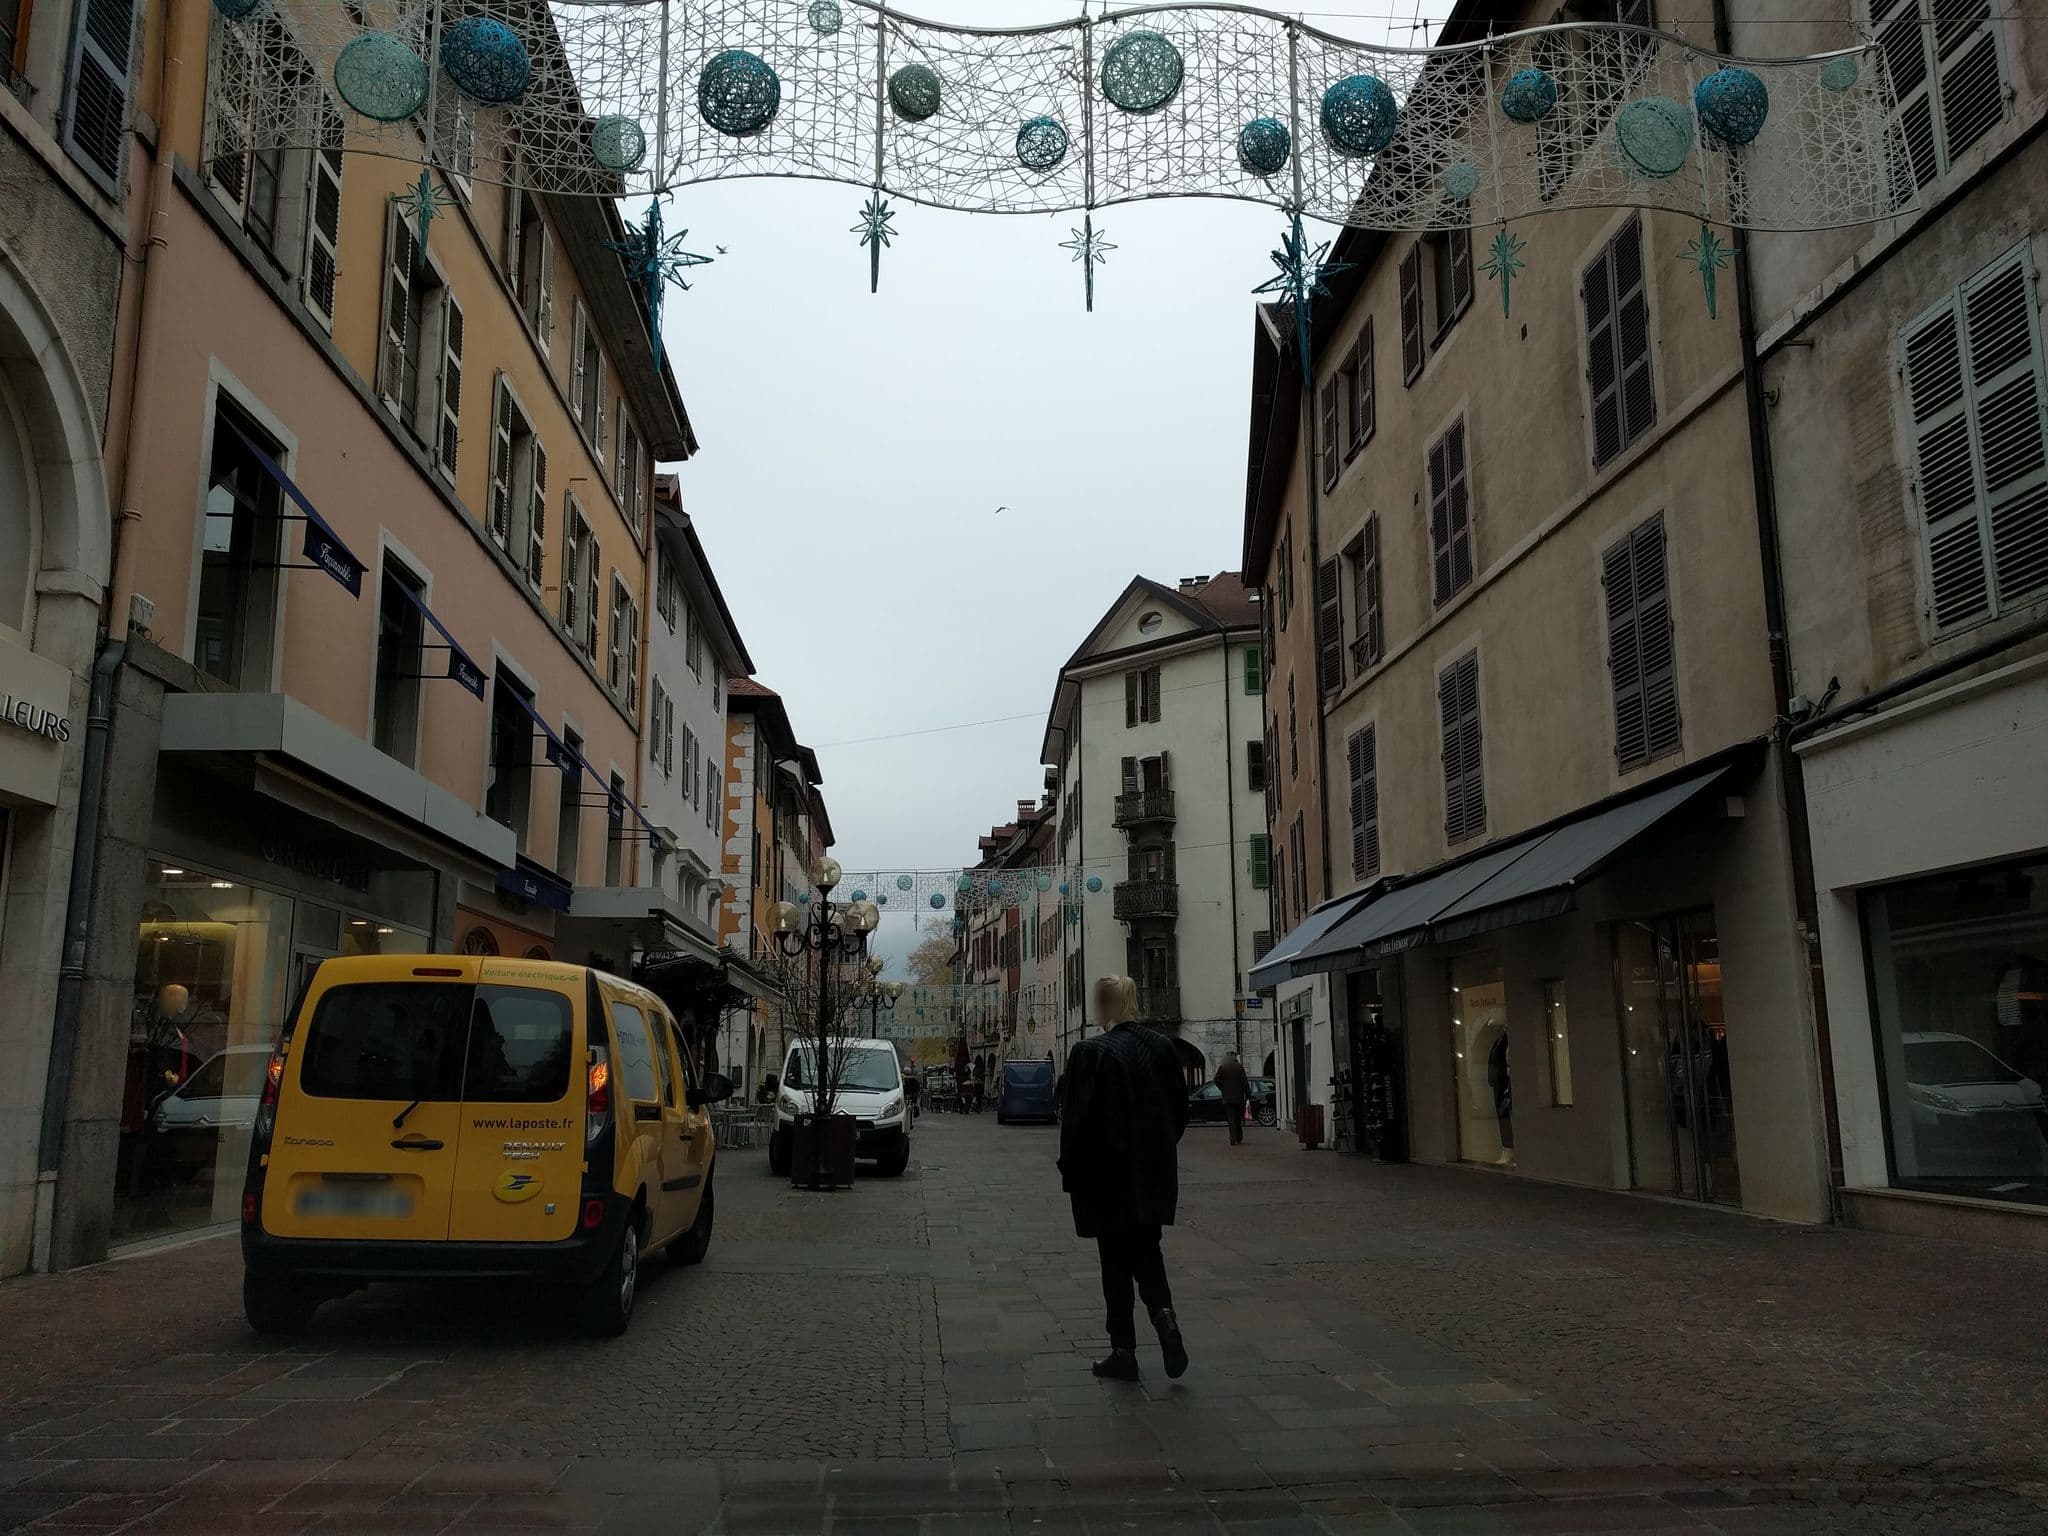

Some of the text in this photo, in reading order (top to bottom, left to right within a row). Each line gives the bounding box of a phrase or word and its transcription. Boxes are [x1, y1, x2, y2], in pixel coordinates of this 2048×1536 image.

[0, 694, 71, 742] LEURS
[473, 1117, 574, 1131] www.laposte.fr
[503, 1142, 567, 1151] RENAULT
